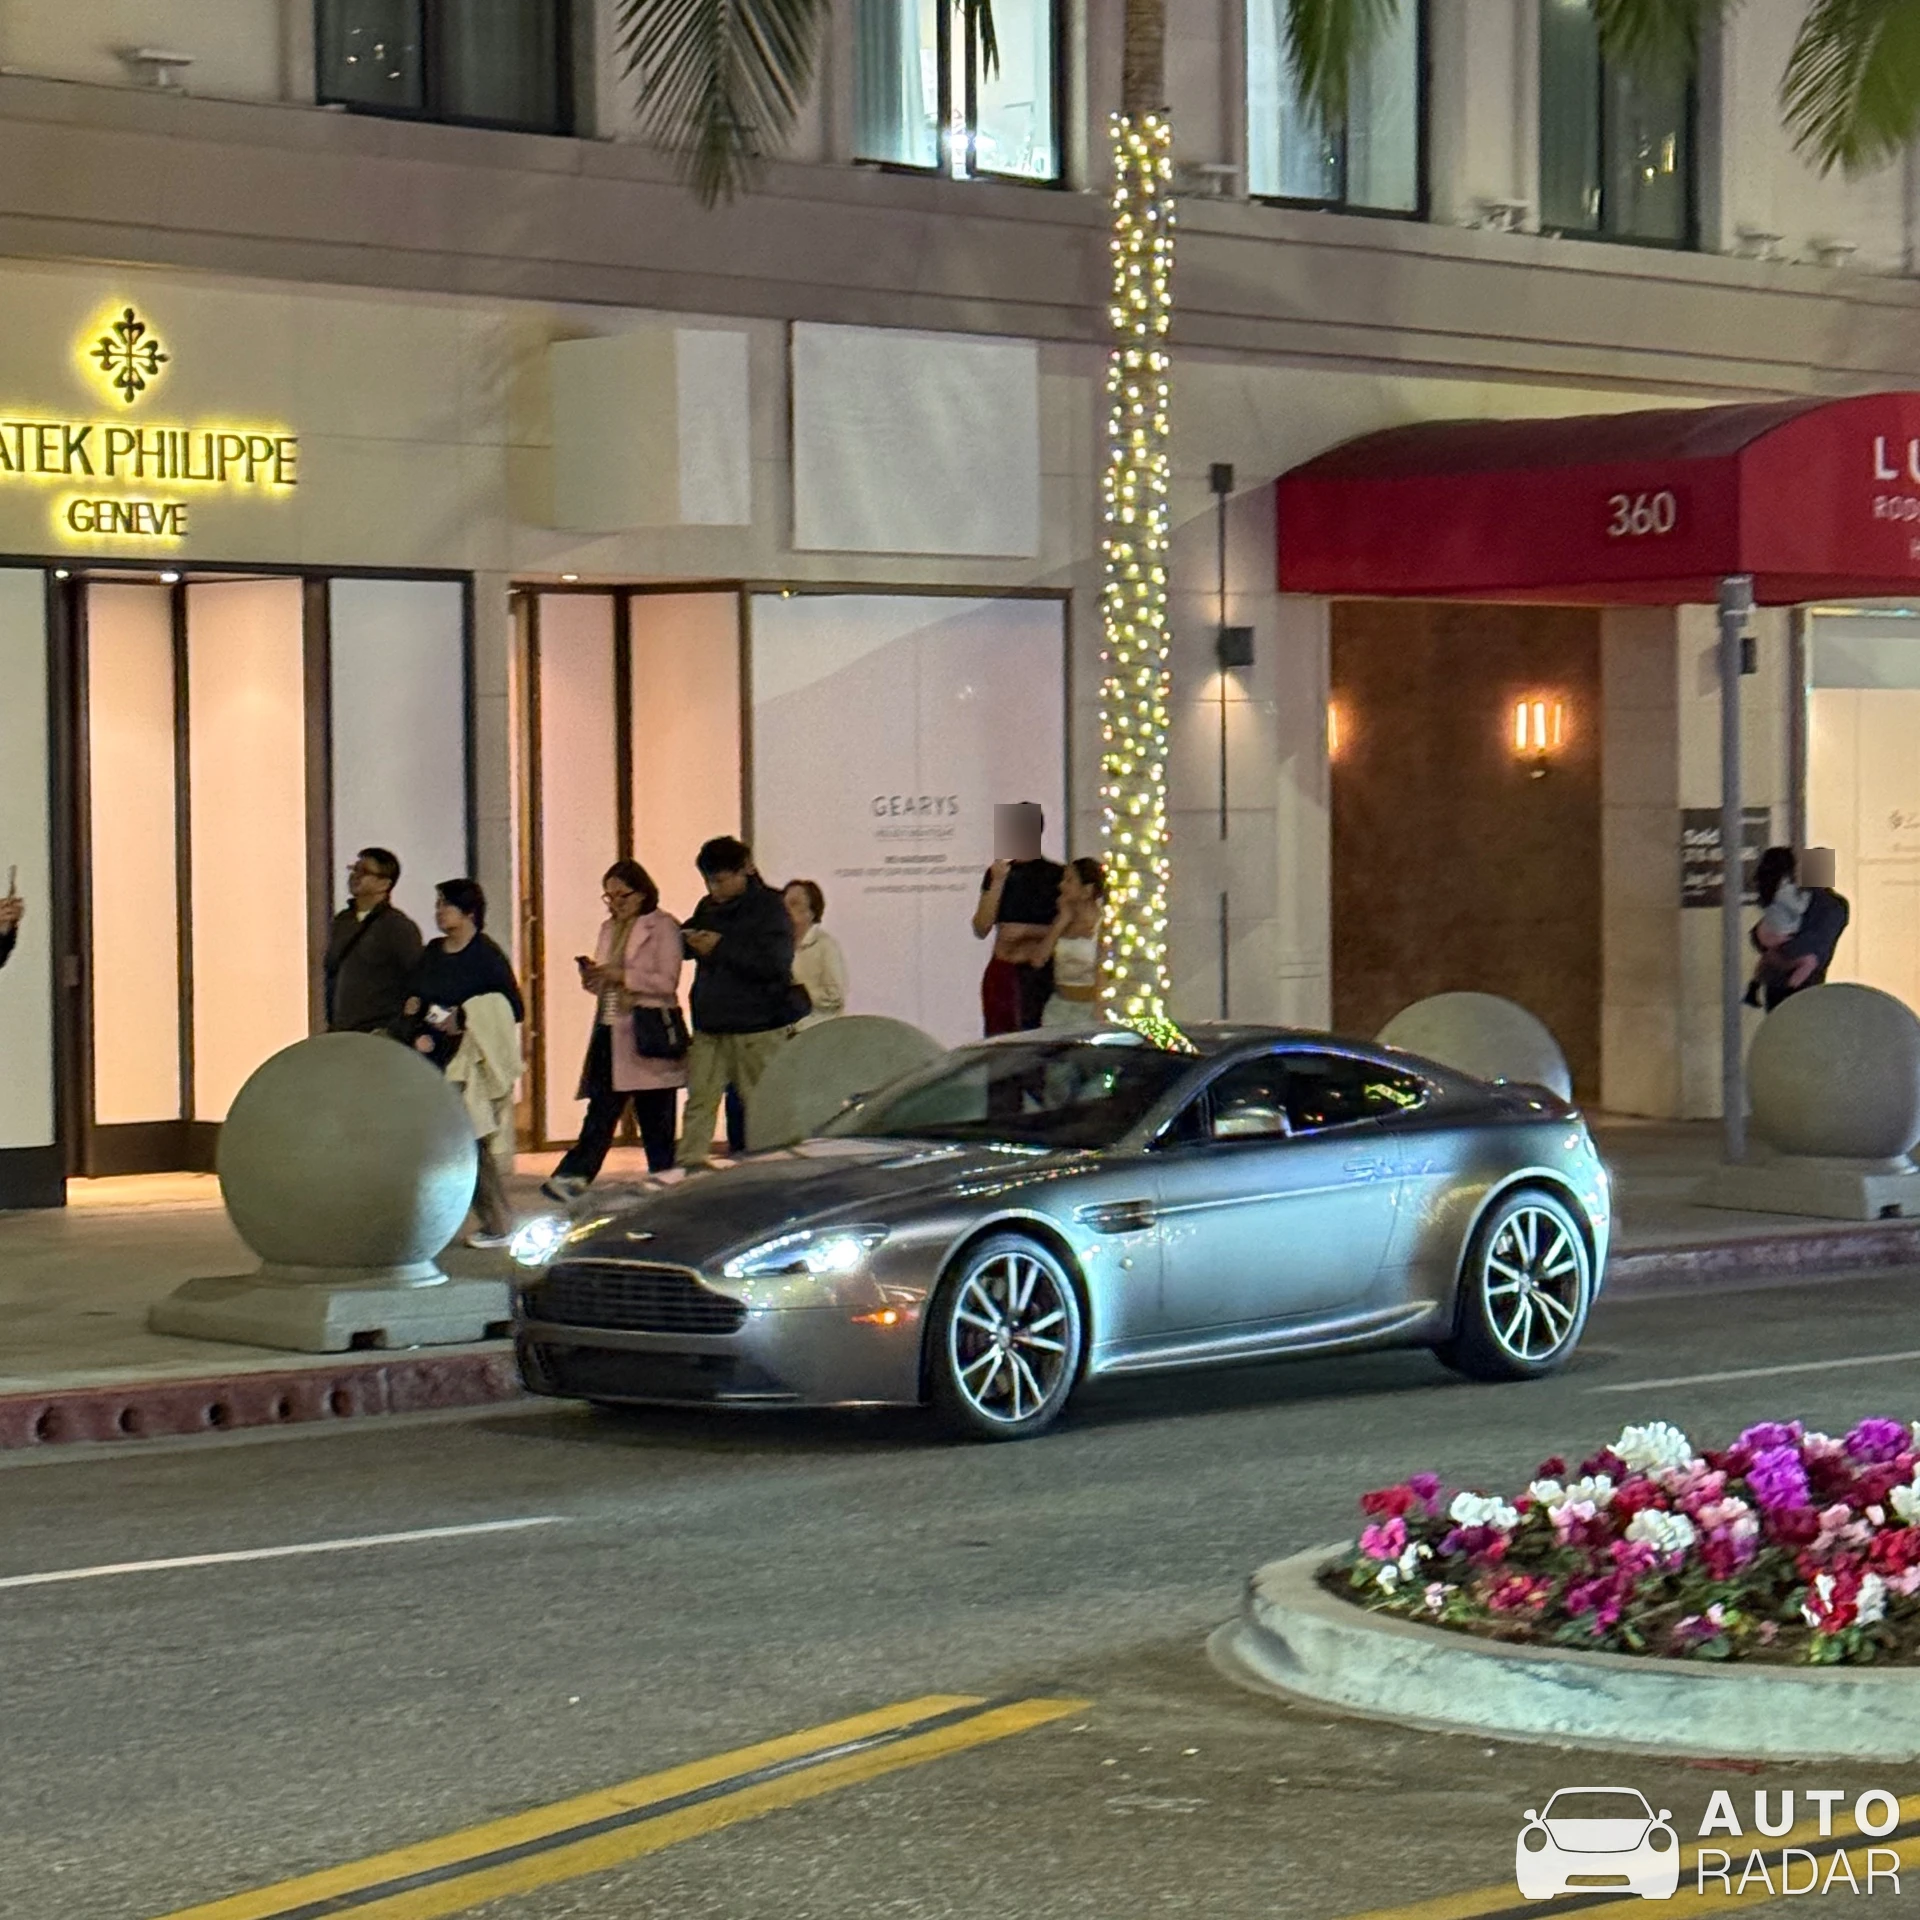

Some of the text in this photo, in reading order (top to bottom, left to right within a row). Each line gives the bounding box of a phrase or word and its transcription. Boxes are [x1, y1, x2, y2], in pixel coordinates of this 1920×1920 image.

[104, 427, 298, 485] PHILIPPE
[66, 499, 188, 536] GENEVE
[1606, 491, 1676, 536] 360
[872, 795, 959, 817] GEARYS
